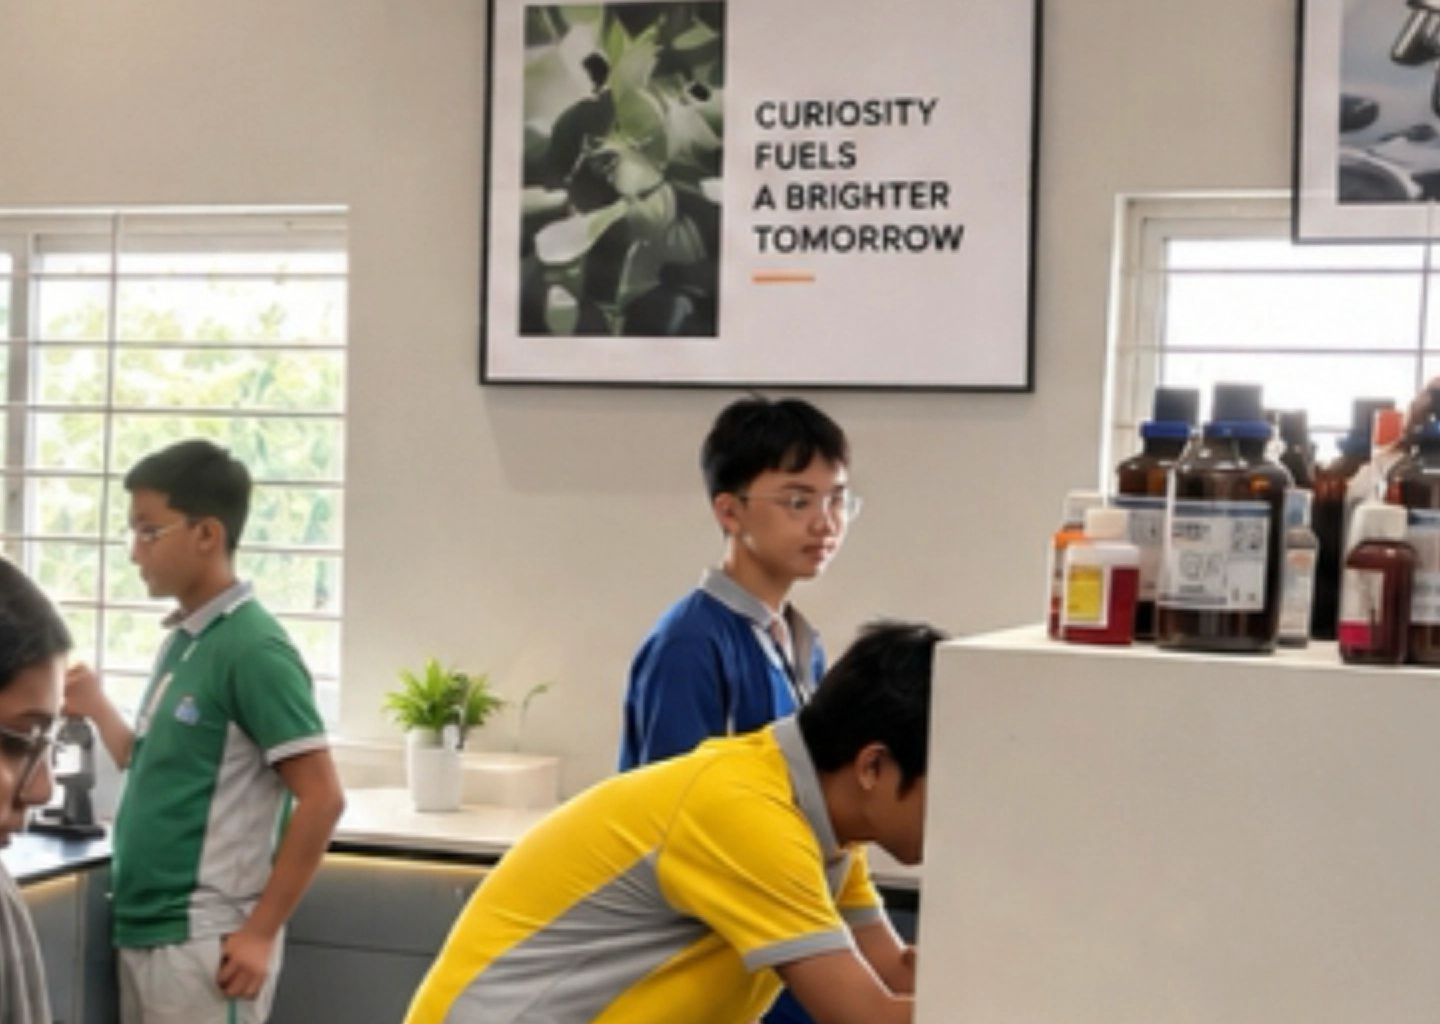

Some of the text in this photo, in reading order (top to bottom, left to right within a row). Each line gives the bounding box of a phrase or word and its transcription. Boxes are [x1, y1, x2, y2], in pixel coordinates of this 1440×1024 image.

[755, 98, 937, 130] CURIOSITY
[754, 141, 857, 171] FUELS
[753, 180, 950, 211] A BRIGHTER
[754, 224, 964, 254] TOMORROW
